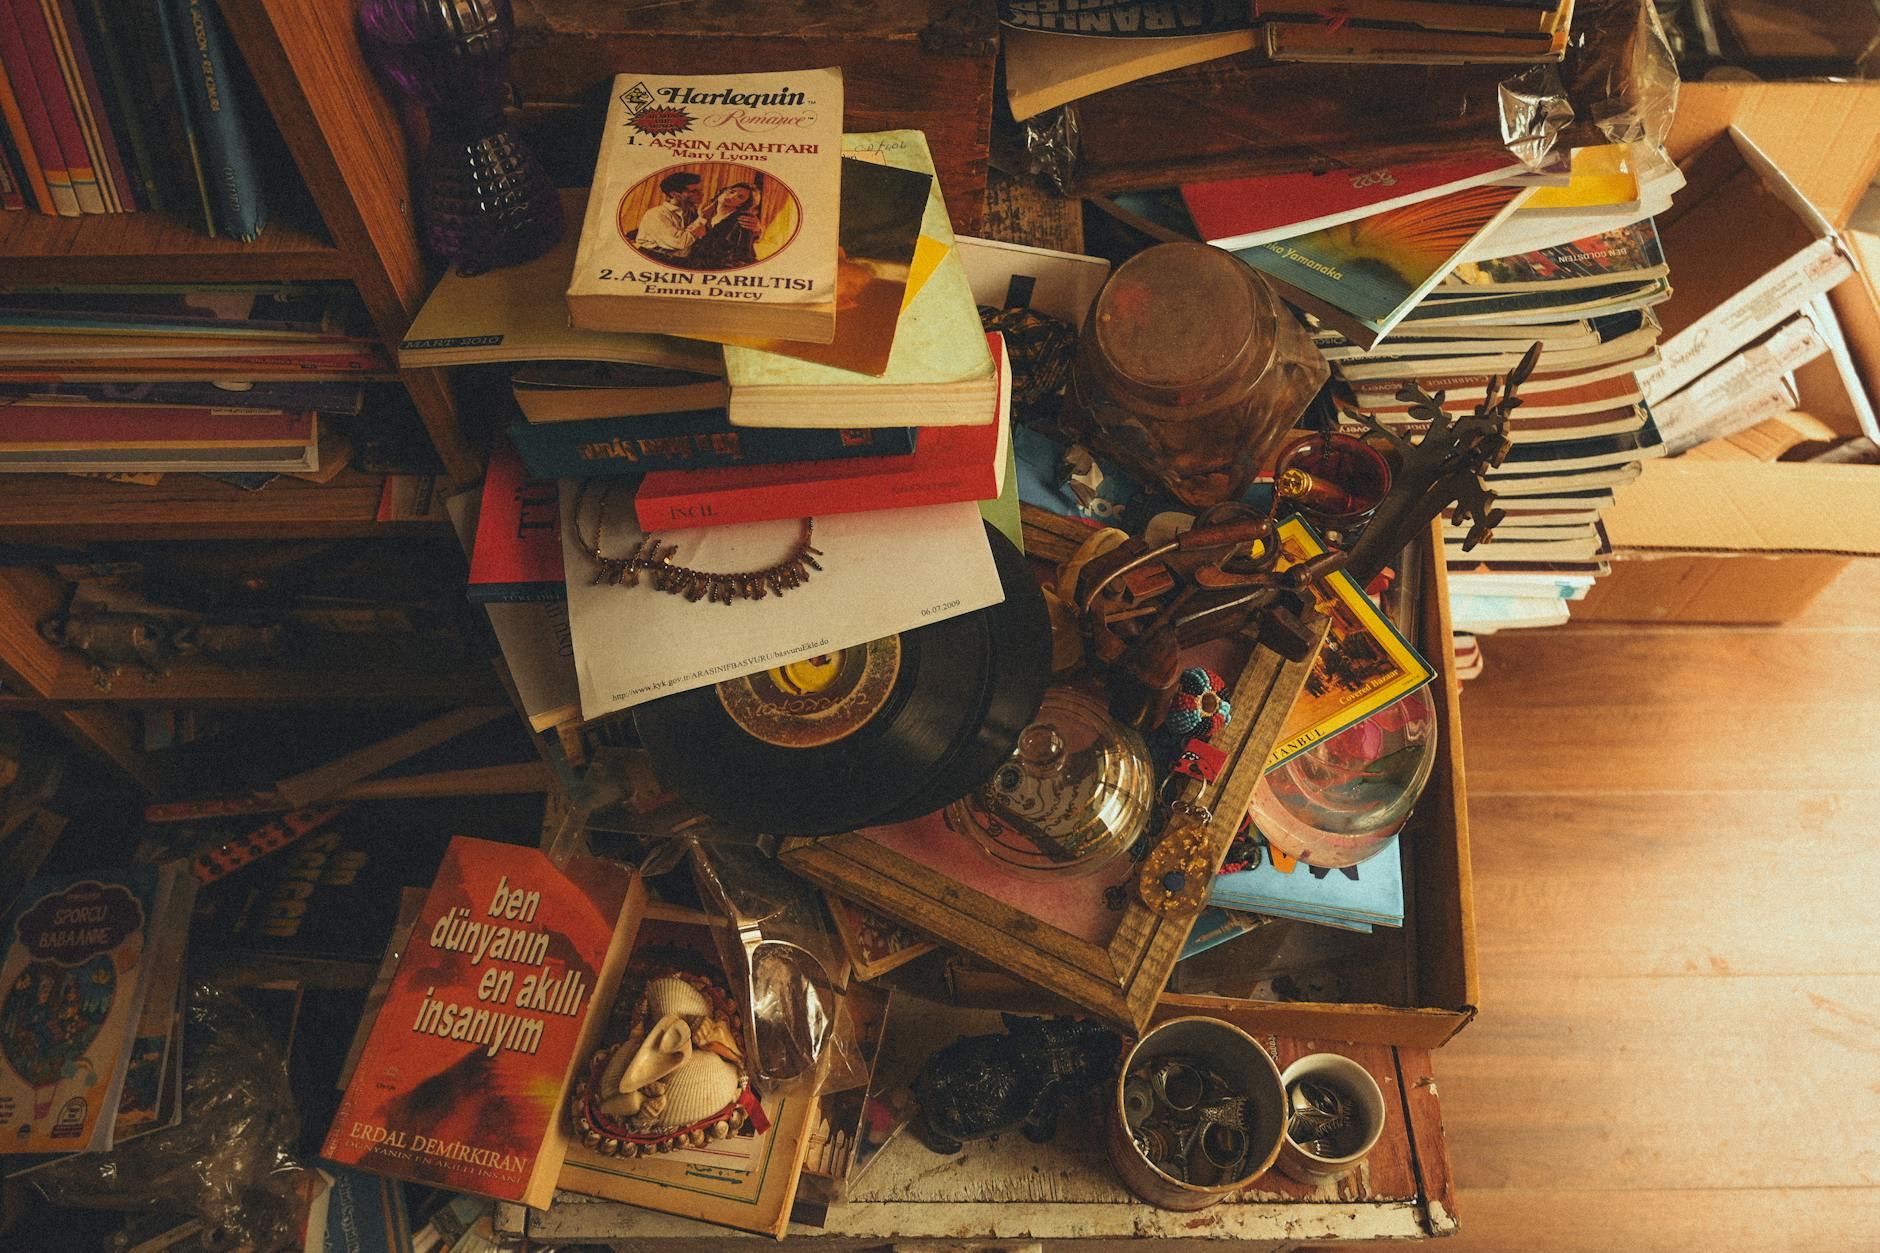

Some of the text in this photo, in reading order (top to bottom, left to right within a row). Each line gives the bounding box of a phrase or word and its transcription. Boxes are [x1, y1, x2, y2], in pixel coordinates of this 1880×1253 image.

[657, 86, 805, 109] Harlequin
[703, 110, 818, 132] Romance
[626, 135, 819, 154] 1. AŞKIN ANAHTARI
[672, 149, 768, 162] Mary Lyons
[1284, 248, 1344, 282] Yamanaka
[1558, 247, 1628, 263] BEN GOLDSTEIN
[644, 285, 763, 301] Emma Darcy
[702, 274, 814, 291] PARILTISI
[405, 335, 500, 349] MART 2010
[921, 599, 961, 617] 06.07.2009
[1339, 683, 1373, 705] Covered
[1372, 669, 1399, 688] Bazaar
[1269, 728, 1327, 764] TANBUL
[488, 875, 541, 923] ben
[430, 907, 550, 965] dünyanın
[478, 966, 587, 1016] en akıllı
[412, 986, 545, 1057] insanıyım
[350, 1122, 528, 1174] ERDAL DEMİRKIRAN
